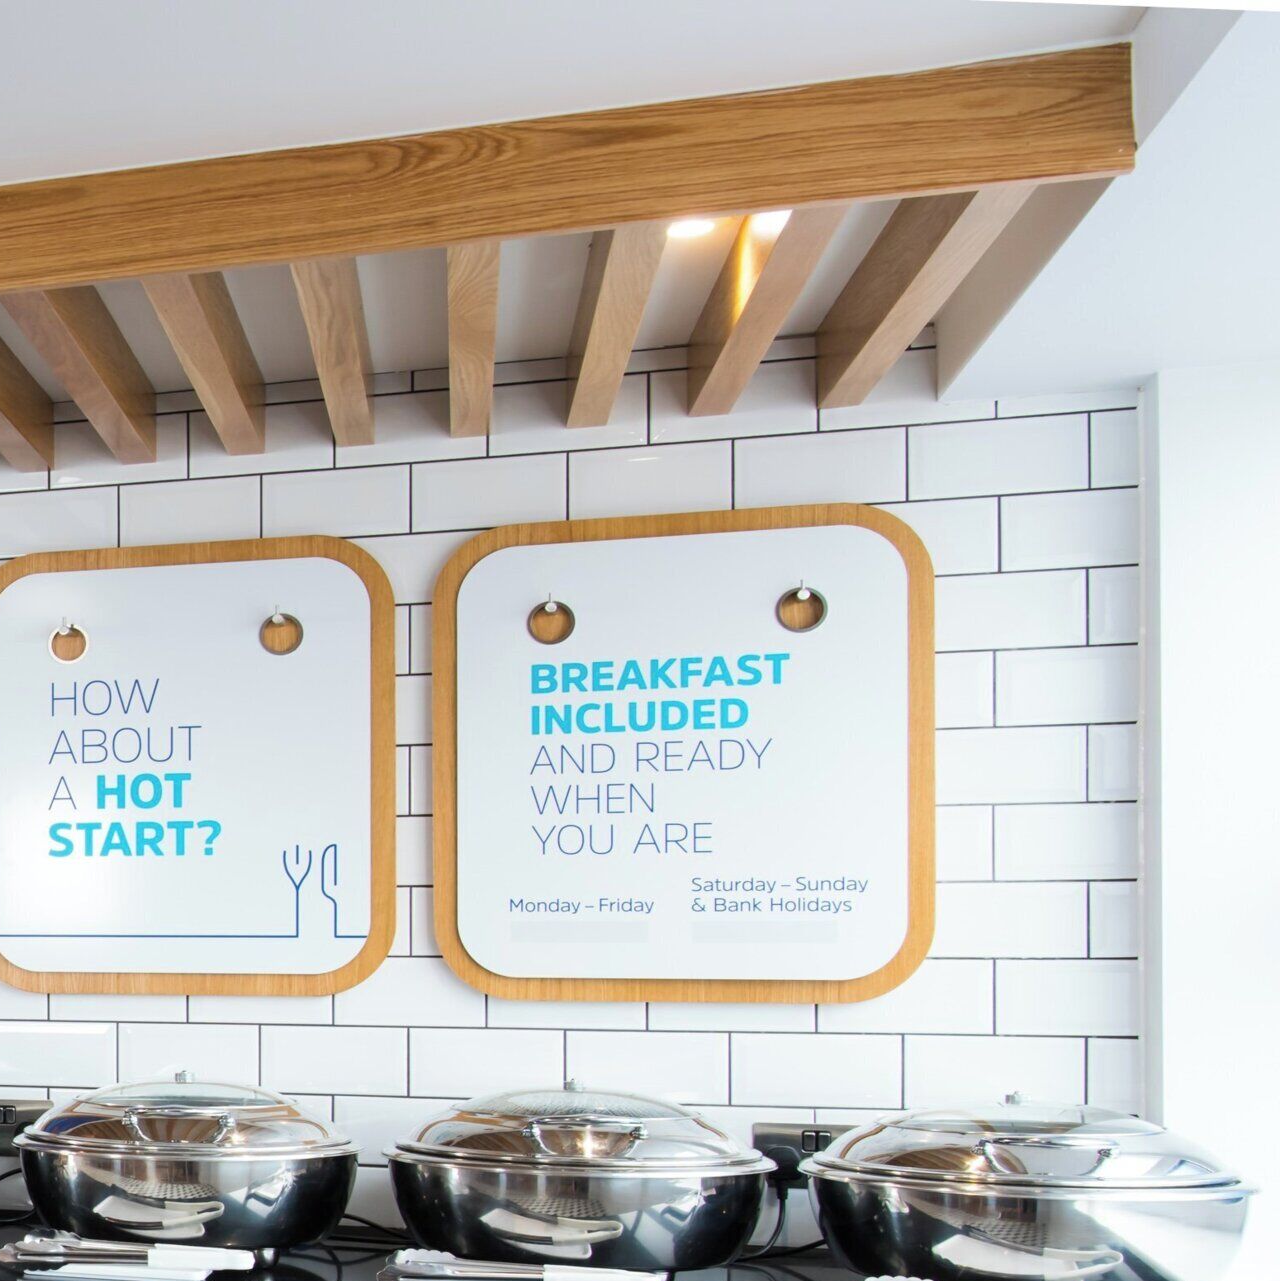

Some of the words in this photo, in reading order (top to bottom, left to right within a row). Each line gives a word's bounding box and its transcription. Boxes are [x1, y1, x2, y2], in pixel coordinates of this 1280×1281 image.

[530, 652, 791, 695] BREAKFAST
[51, 677, 160, 717] HOW
[530, 697, 749, 736] INCLUDED
[48, 725, 202, 765] ABOUT
[530, 743, 616, 776] AND
[635, 737, 773, 772] READY
[48, 775, 78, 811] A
[96, 772, 192, 810] HOT
[530, 783, 655, 816] WHEN
[48, 820, 222, 858] START?
[531, 824, 614, 856] YOU
[633, 822, 713, 854] ARE
[690, 876, 777, 894] Saturday
[795, 875, 869, 893] Sunday
[508, 898, 581, 915] Monday
[598, 898, 655, 915] Friday
[691, 898, 705, 914] &
[713, 897, 762, 913] Bank
[770, 897, 852, 915] Holidays
